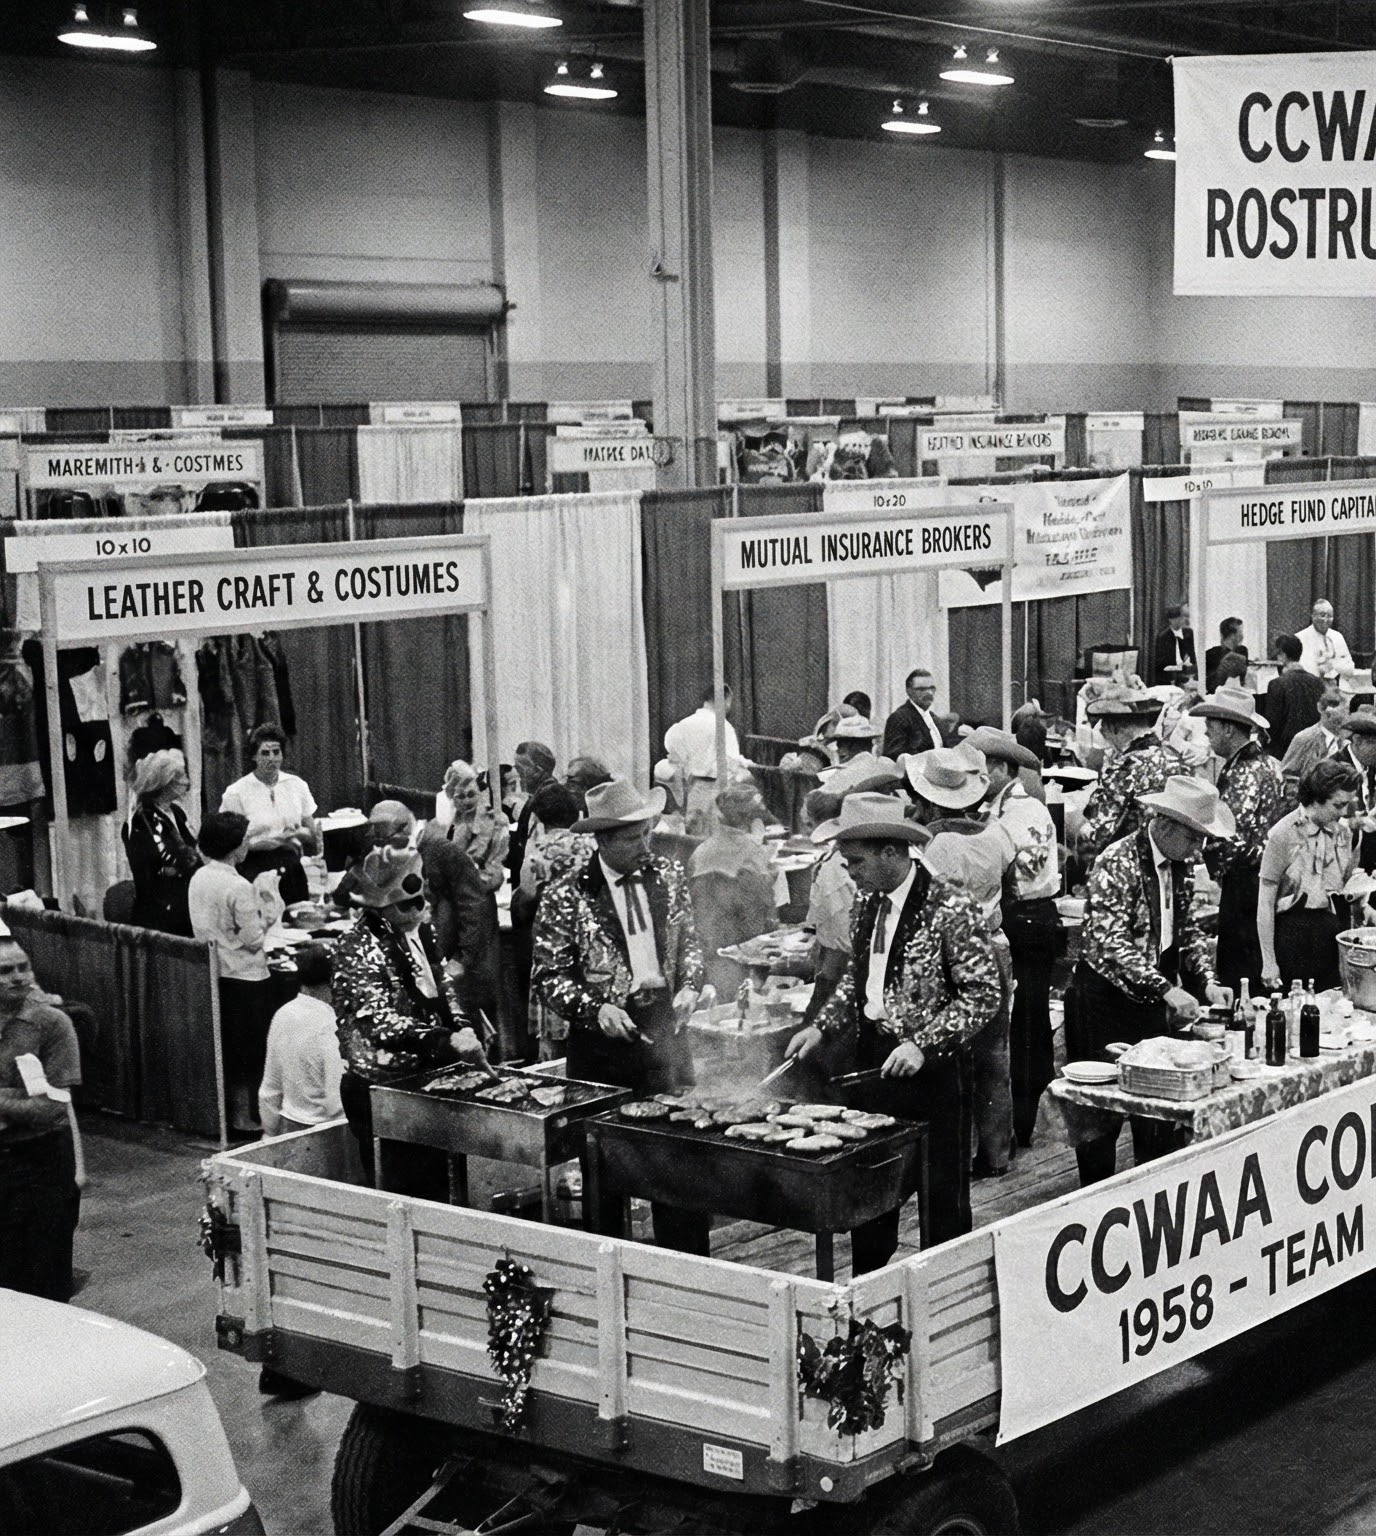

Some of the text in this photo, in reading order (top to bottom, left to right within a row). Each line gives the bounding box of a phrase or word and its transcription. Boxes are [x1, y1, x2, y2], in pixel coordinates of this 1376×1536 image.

[1241, 501, 1285, 527] HEDGE
[1291, 499, 1326, 523] FUND
[741, 536, 813, 569] MUTUAL
[821, 529, 914, 562] INSURANCE
[922, 523, 992, 554] BROKERS
[87, 561, 459, 621] LEATHER CRAFT & COSTUMES
[1045, 1152, 1272, 1313] CCWAA
[1119, 1274, 1214, 1364] 1958
[1261, 1204, 1364, 1295] TEAM
